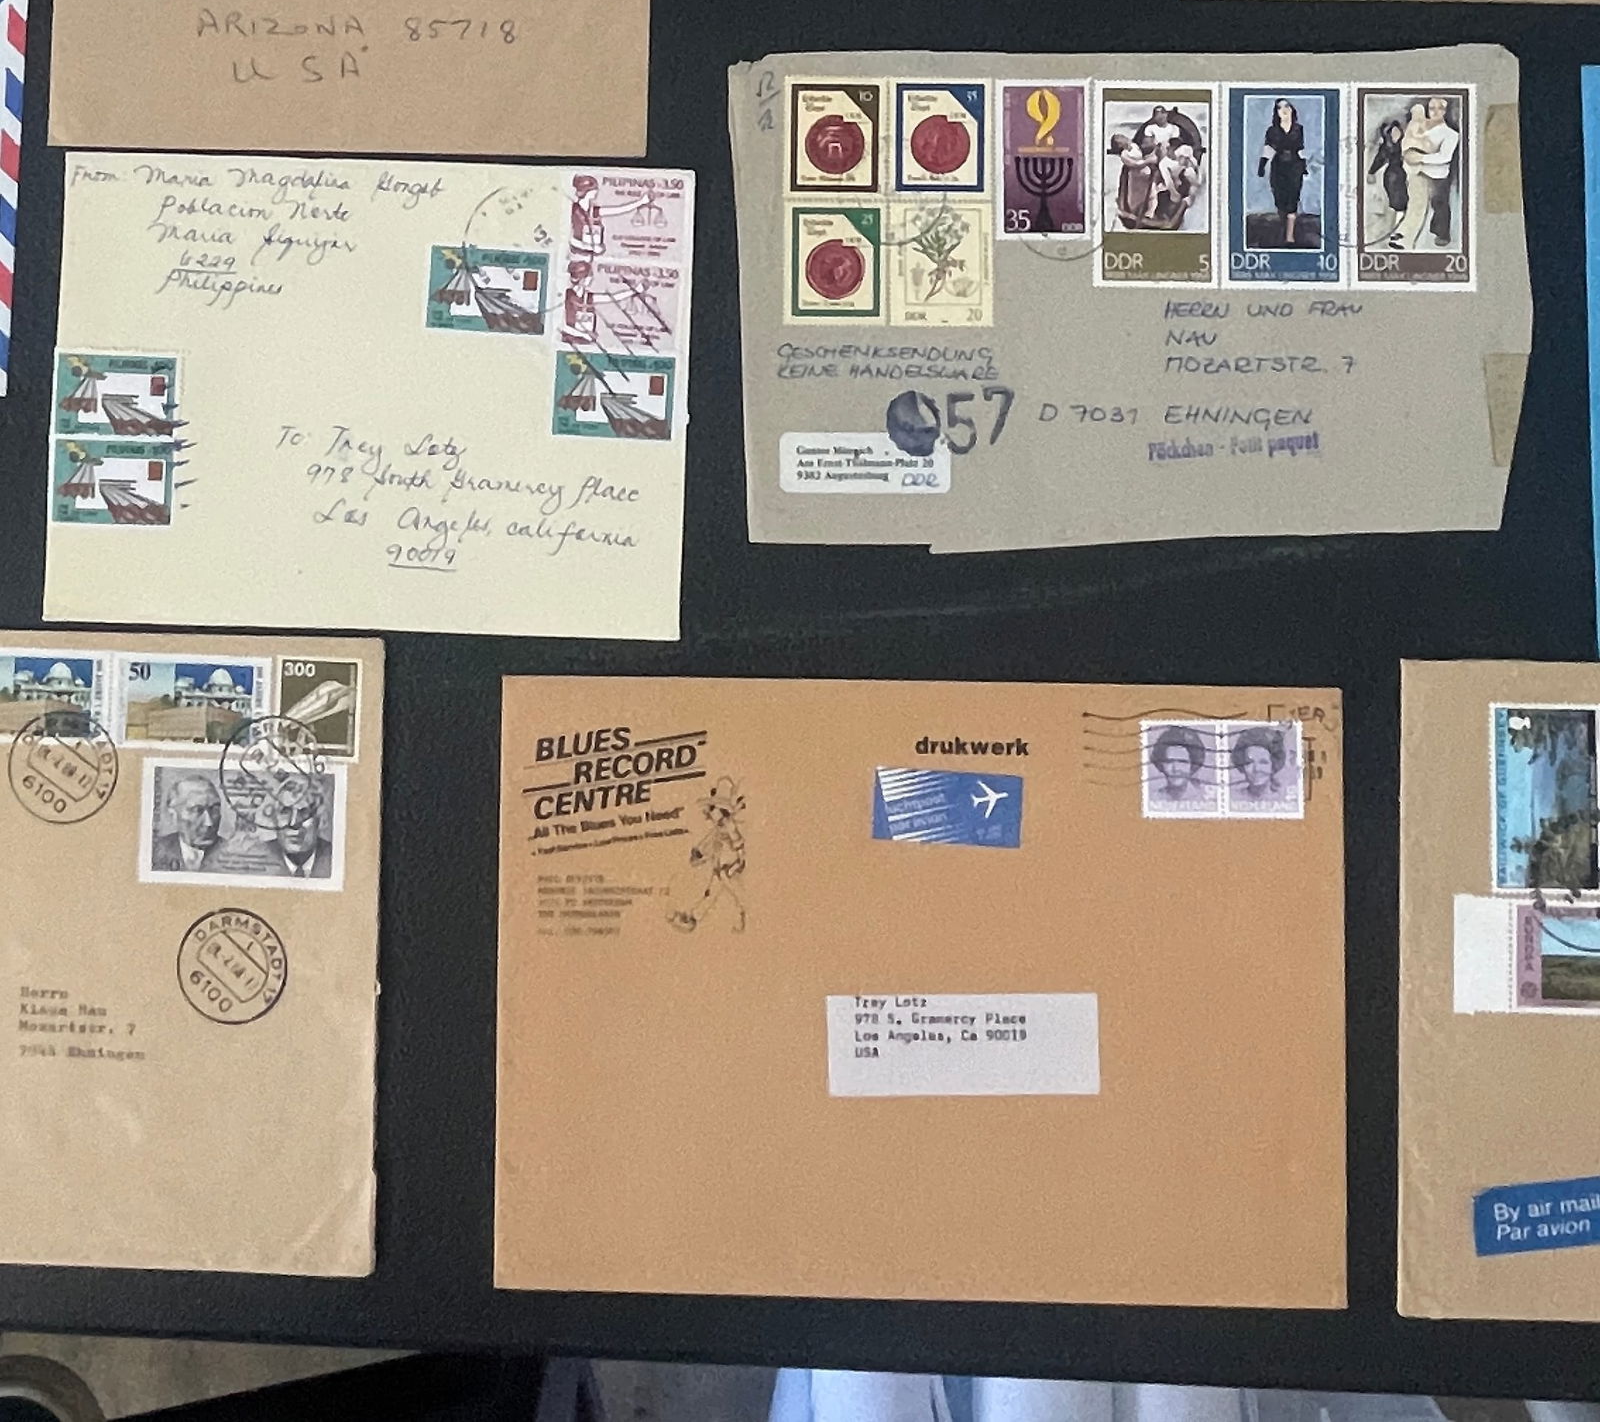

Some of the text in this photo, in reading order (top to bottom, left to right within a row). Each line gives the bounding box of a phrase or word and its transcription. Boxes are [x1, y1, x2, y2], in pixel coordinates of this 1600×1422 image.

[196, 7, 517, 45] ARIZONA 85718
[602, 176, 656, 189] PILIPINAS
[860, 213, 875, 226] 25
[1006, 208, 1032, 232] 35
[1103, 252, 1210, 271] DDR 5
[1230, 252, 1338, 271] DDR 10
[1358, 253, 1468, 273] DDR 20
[154, 268, 284, 310] Philippines
[966, 307, 984, 323] 20
[1163, 300, 1364, 320] HERRN UND FRAU
[1165, 330, 1218, 348] NAU
[777, 342, 994, 369] GESCHENKSENDUNG
[1341, 355, 1358, 375] 7
[777, 364, 839, 379] KEINE
[1038, 402, 1314, 431] D 7031 EHNINGEN
[323, 424, 384, 474] Trey
[1267, 430, 1320, 458] paquet
[305, 463, 355, 485] 978
[385, 543, 458, 565] 90019
[128, 661, 316, 682] 50 300
[535, 726, 633, 762] BLUES
[915, 736, 1030, 756] drukwerk
[573, 744, 698, 785] RECORD
[21, 774, 68, 815] 6100
[533, 781, 652, 820] CENTRE
[552, 813, 643, 837] The You
[193, 915, 284, 982] DARMSTADT
[188, 969, 234, 1014] 6100
[854, 996, 927, 1009] Trey Lotz
[126, 1022, 137, 1037] 7
[854, 1013, 879, 1025] 978
[911, 1013, 976, 1027] Gramercy
[985, 1012, 1026, 1025] Place
[854, 1029, 1027, 1045] Los Angeles, Ca 90019
[854, 1047, 880, 1059] USA
[1493, 1202, 1520, 1223] By
[1527, 1201, 1553, 1219] air
[1496, 1218, 1591, 1242] Par avion
